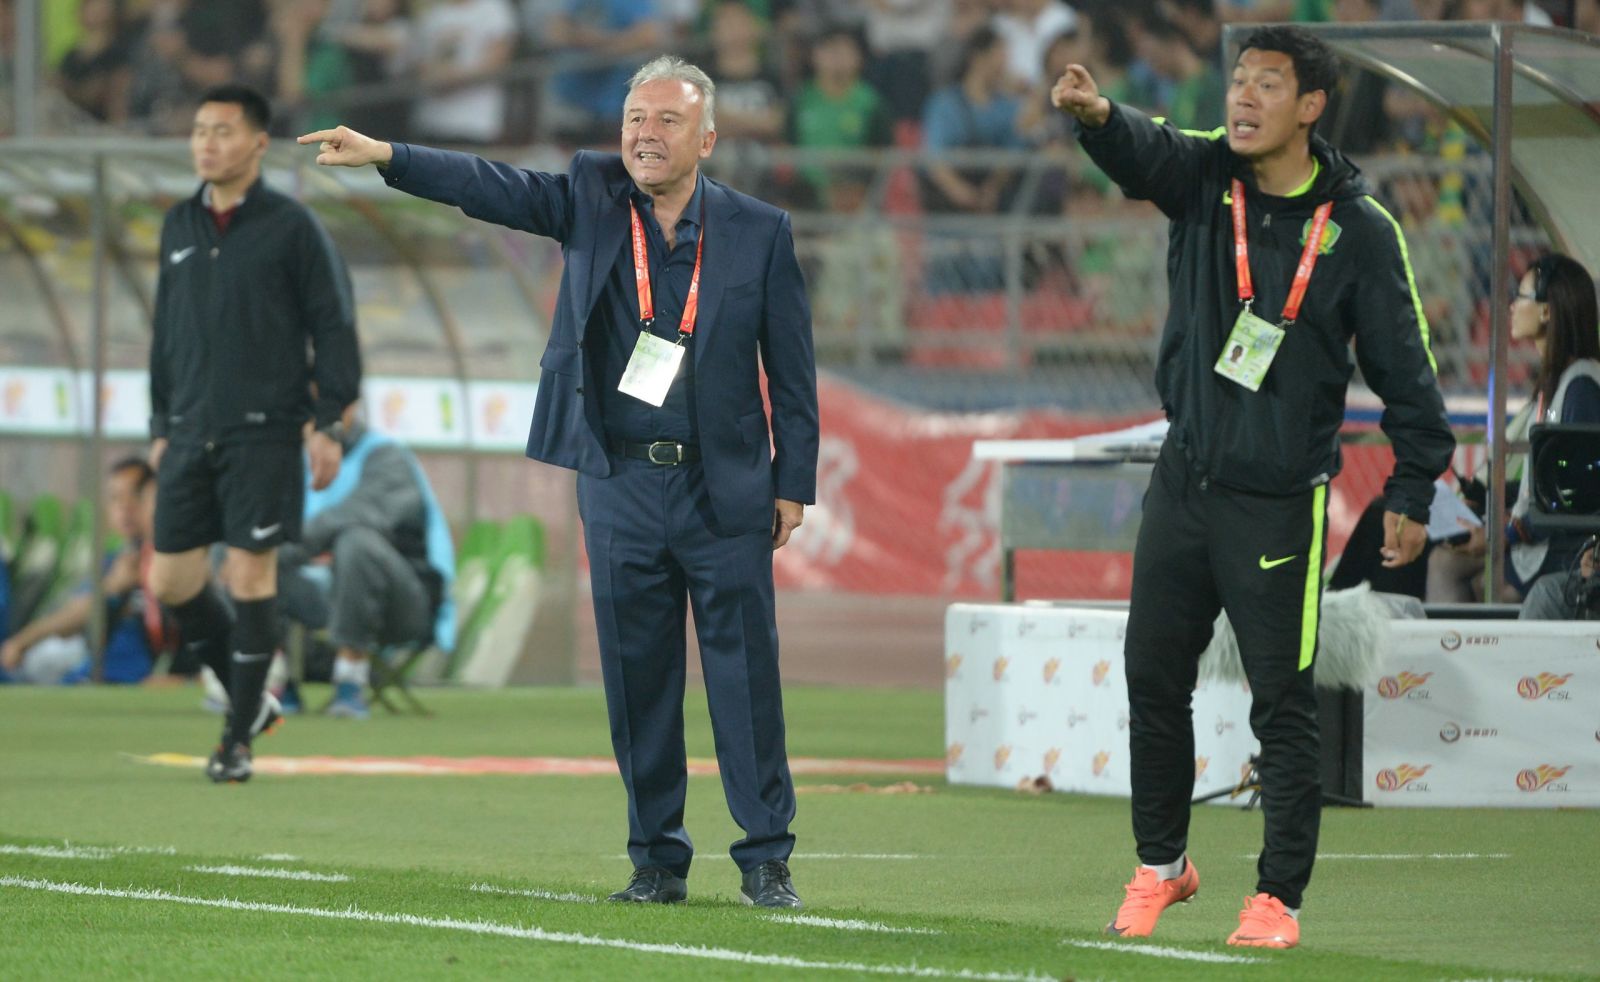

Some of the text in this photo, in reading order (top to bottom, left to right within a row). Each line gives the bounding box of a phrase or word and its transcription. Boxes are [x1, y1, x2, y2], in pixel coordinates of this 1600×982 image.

[1407, 689, 1432, 700] CSL
[1547, 690, 1572, 700] CSL
[1406, 782, 1431, 792] CSL
[1546, 782, 1572, 792] CSL
